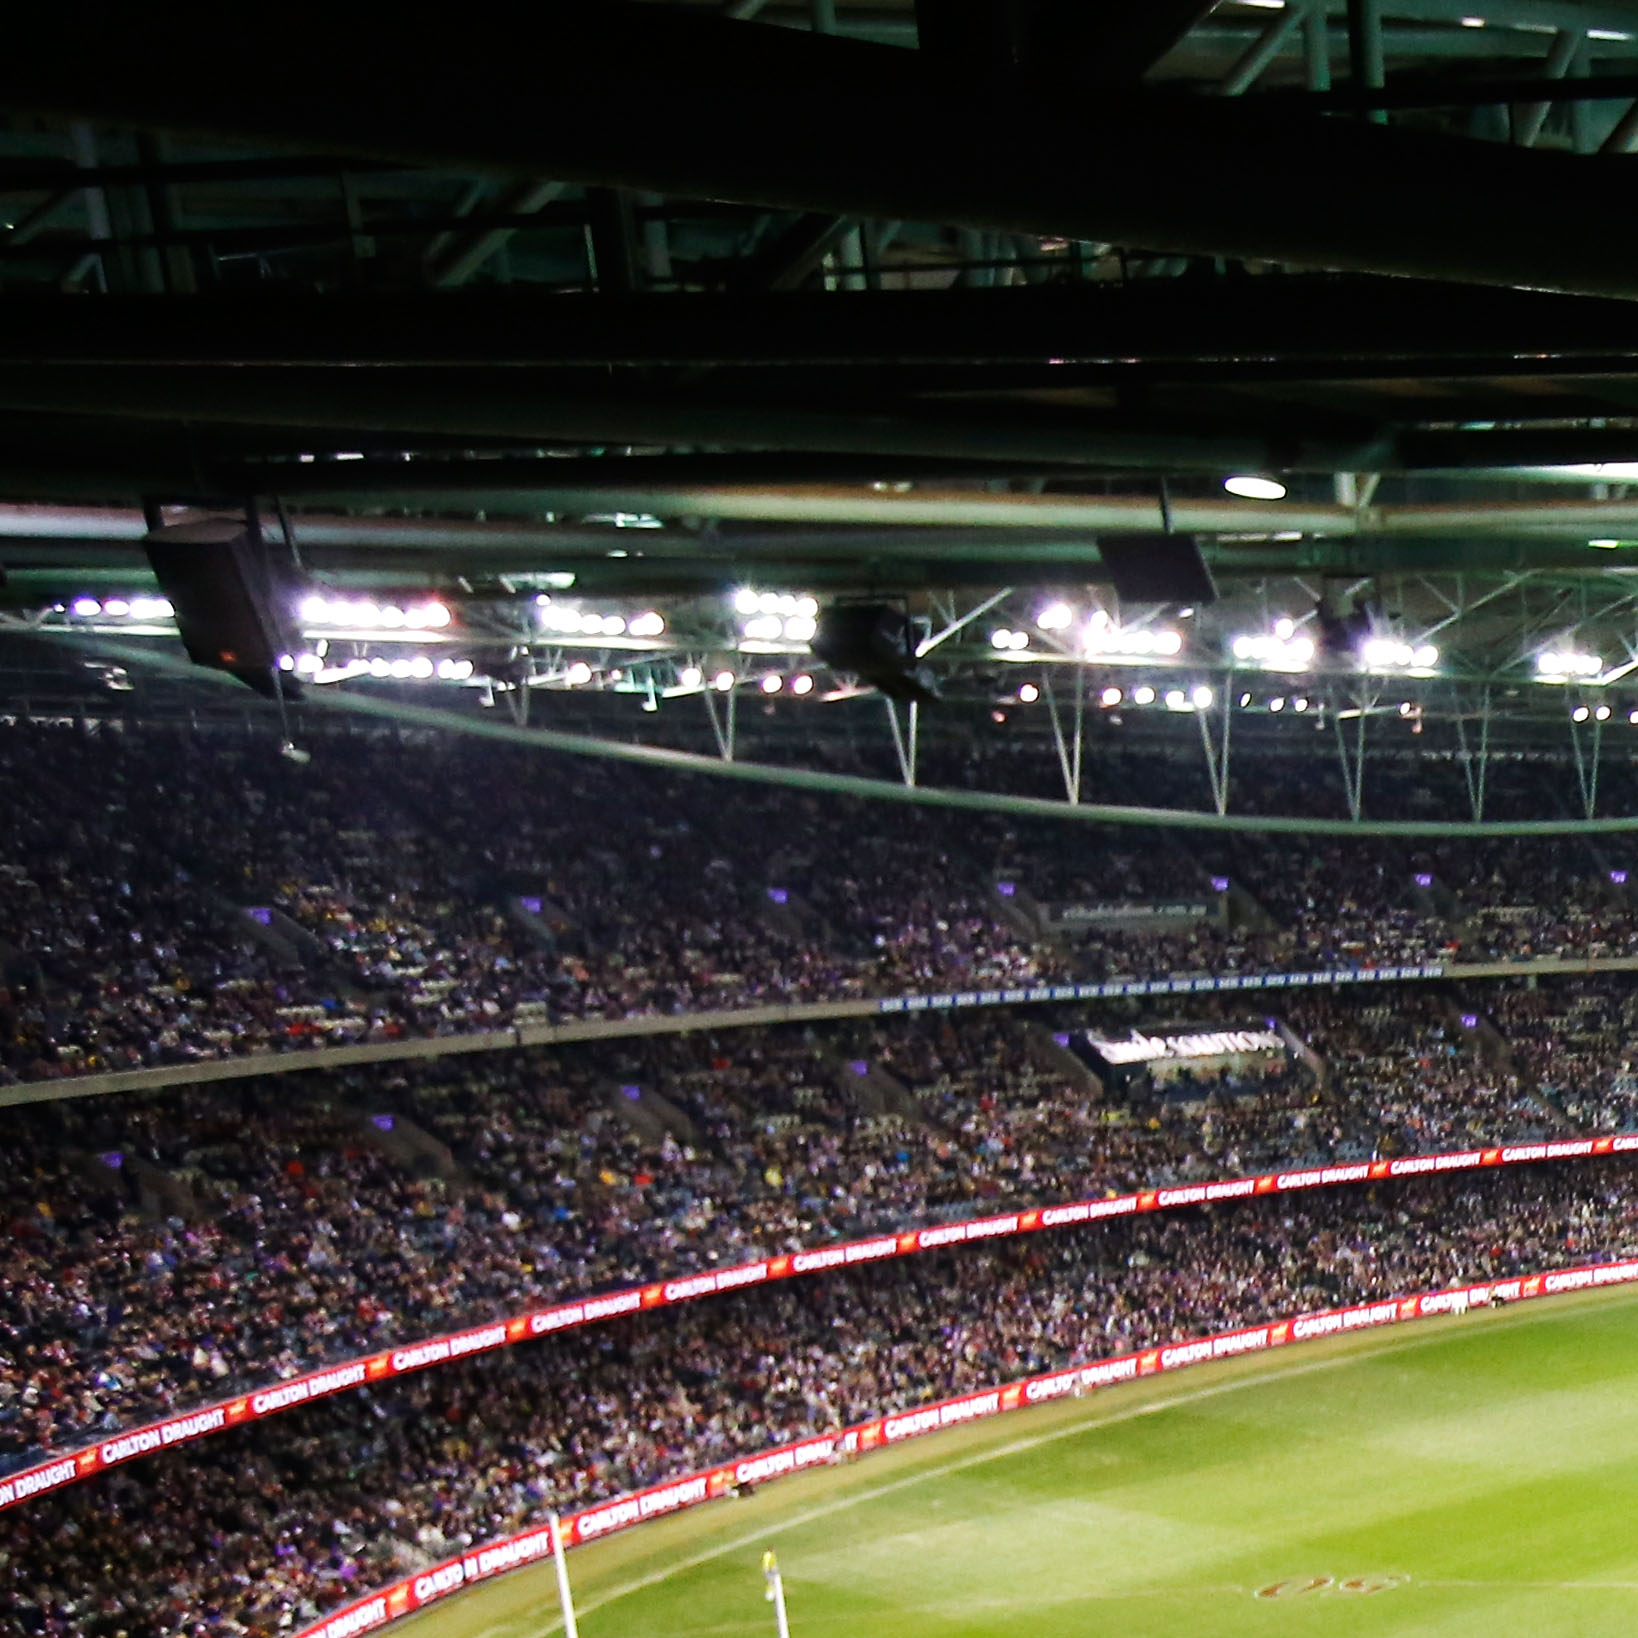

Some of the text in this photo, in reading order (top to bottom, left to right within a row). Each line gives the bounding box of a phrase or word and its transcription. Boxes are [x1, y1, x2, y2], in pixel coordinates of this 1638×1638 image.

[1278, 1166, 1368, 1188] CARLTON DRAUGHT
[1391, 1153, 1480, 1174] CARLTON DRAUGHT
[1043, 1197, 1136, 1225] CARLTON DRAUGHT
[1159, 1181, 1253, 1205] CARLTON DRAUGHT
[919, 1217, 1017, 1247] CARLTON DRAUGHT
[794, 1239, 896, 1271] CARLTON DRAUGHT
[666, 1265, 766, 1300] CARLTON DRAUGHT
[532, 1294, 639, 1333] CARLTON DRAUGHT
[1294, 1303, 1396, 1338] CARLTON DRAUGHT
[393, 1326, 505, 1370] CARLTON DRAUGHT
[1162, 1329, 1267, 1367] CARLTON DRAUGHT
[253, 1364, 364, 1415] CARLTON DRAUGHT
[885, 1393, 998, 1440] CARLTON DRAUGHT
[103, 1409, 223, 1463] CARLTON DRAUGHT
[15, 1459, 75, 1498] DRAUGHT
[737, 1450, 794, 1484] CARLTON
[578, 1478, 705, 1538] CARLTON DRAUGHT
[479, 1531, 548, 1573] DRAUGHT
